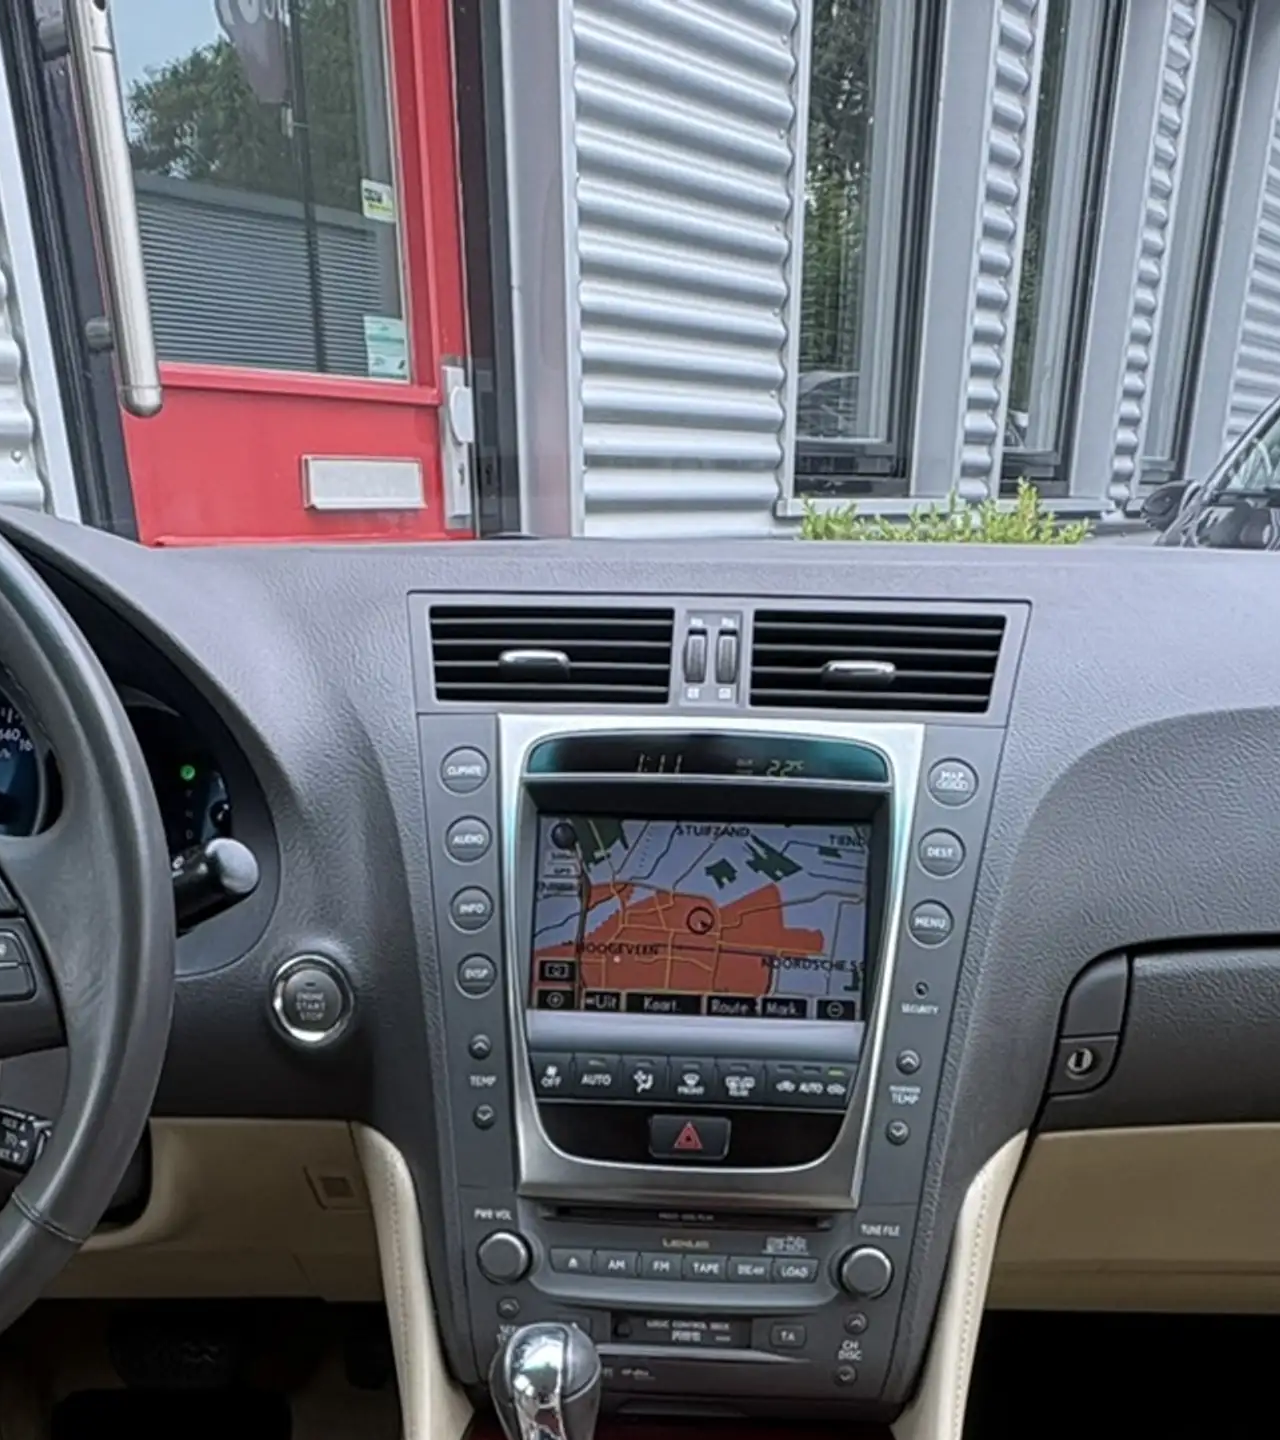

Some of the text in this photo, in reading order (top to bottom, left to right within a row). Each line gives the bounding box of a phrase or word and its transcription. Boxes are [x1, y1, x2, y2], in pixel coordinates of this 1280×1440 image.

[0, 729, 20, 741] 140
[452, 834, 484, 844] AUDIO
[459, 903, 485, 914] INFO
[914, 916, 946, 928] MENU
[469, 1075, 497, 1086] TEMP
[581, 1073, 611, 1086] AUTO
[798, 1082, 824, 1094] AUTO
[608, 1260, 625, 1270] AM
[653, 1261, 670, 1272] FM
[693, 1262, 719, 1274] TAPE
[780, 1266, 809, 1278] LOAD
[780, 1331, 796, 1342] TA
